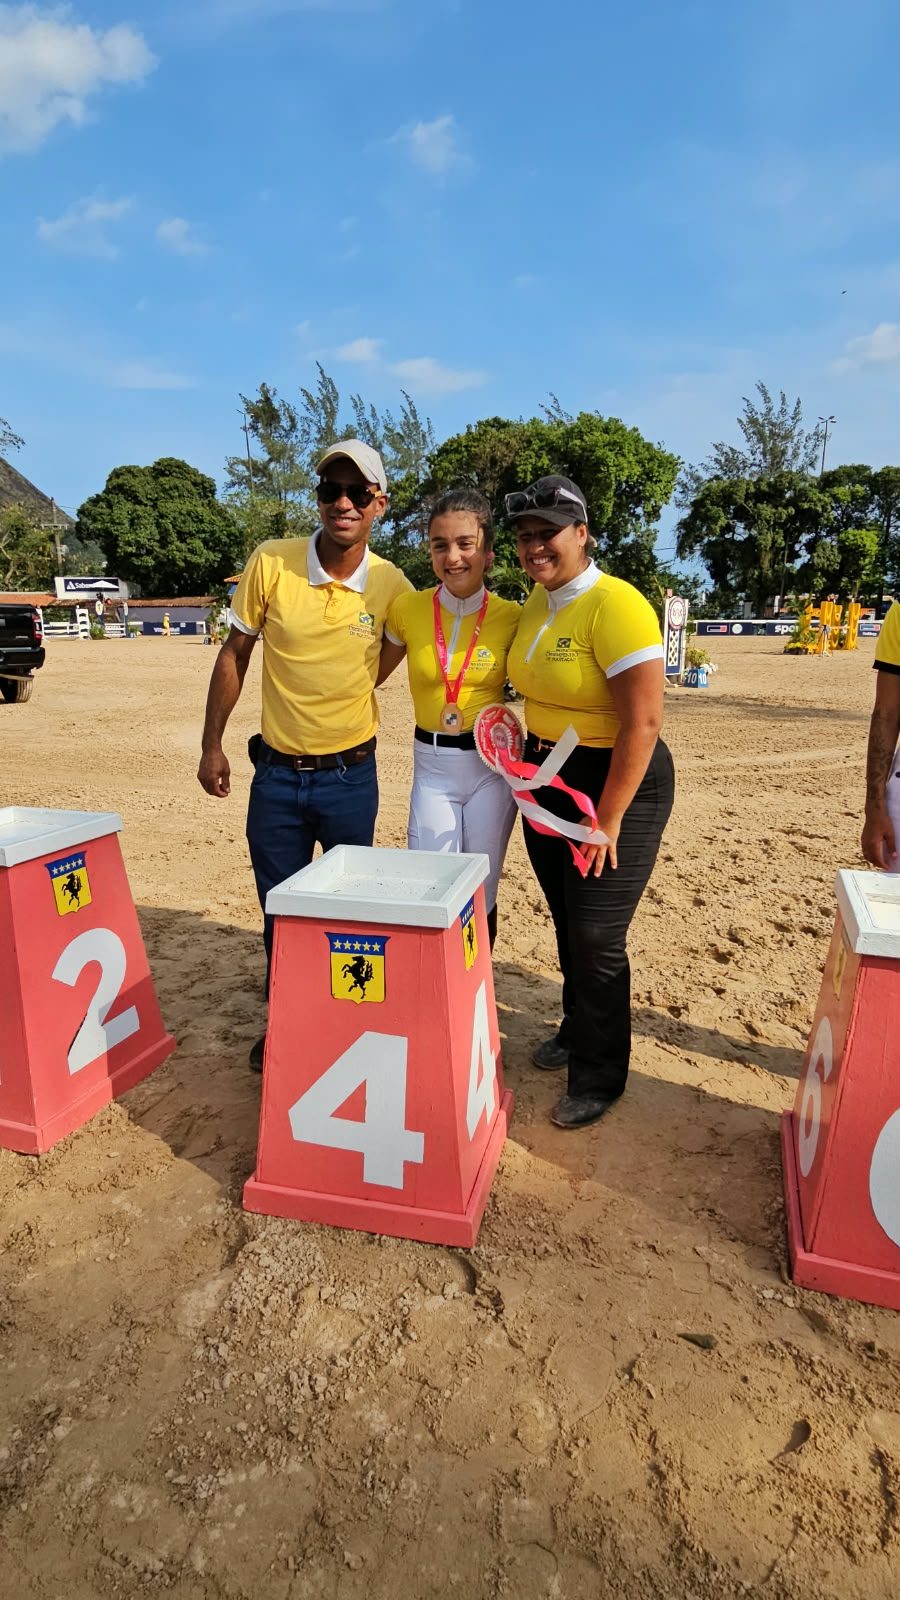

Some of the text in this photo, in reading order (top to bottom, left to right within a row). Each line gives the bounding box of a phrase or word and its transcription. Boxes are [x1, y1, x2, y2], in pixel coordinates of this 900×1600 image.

[687, 672, 697, 684] 10
[698, 673, 707, 685] 10
[774, 625, 799, 635] spor
[52, 928, 140, 1076] 2
[466, 979, 498, 1142] 4
[288, 1031, 424, 1189] 4
[798, 1016, 833, 1178] 6
